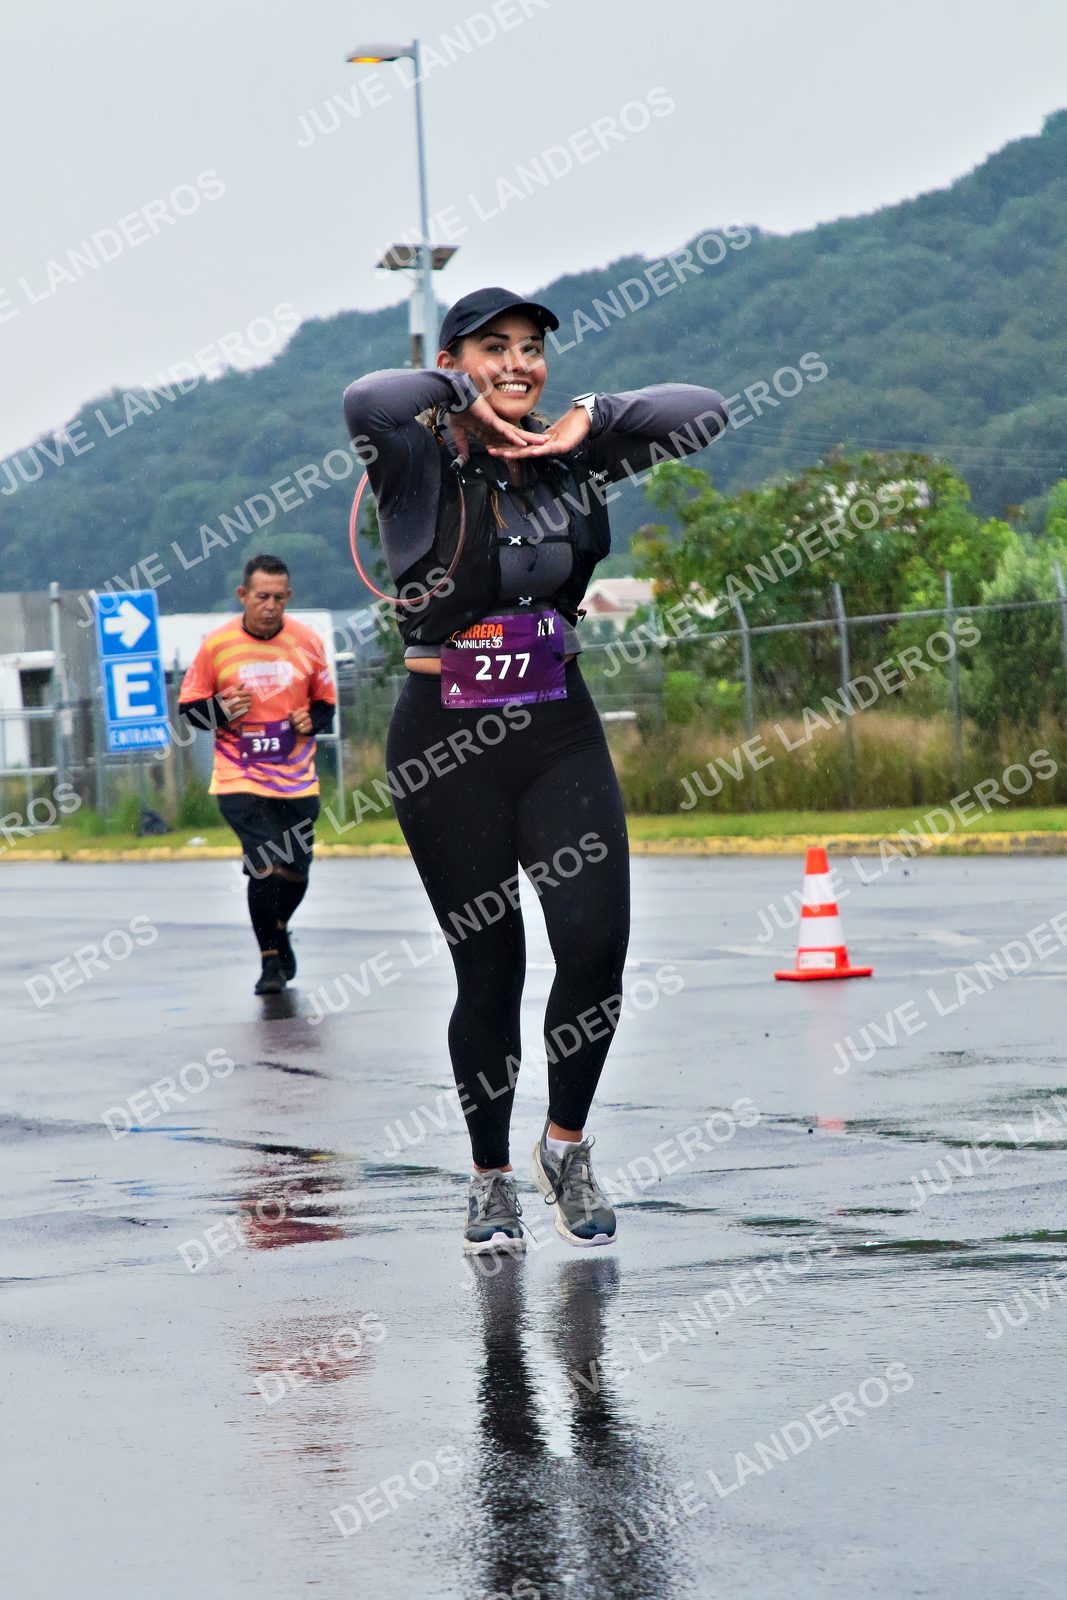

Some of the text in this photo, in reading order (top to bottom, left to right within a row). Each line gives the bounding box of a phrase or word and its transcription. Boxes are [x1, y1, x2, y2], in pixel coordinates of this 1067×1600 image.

[475, 652, 531, 681] 277
[112, 661, 157, 719] E
[252, 737, 280, 753] 373
